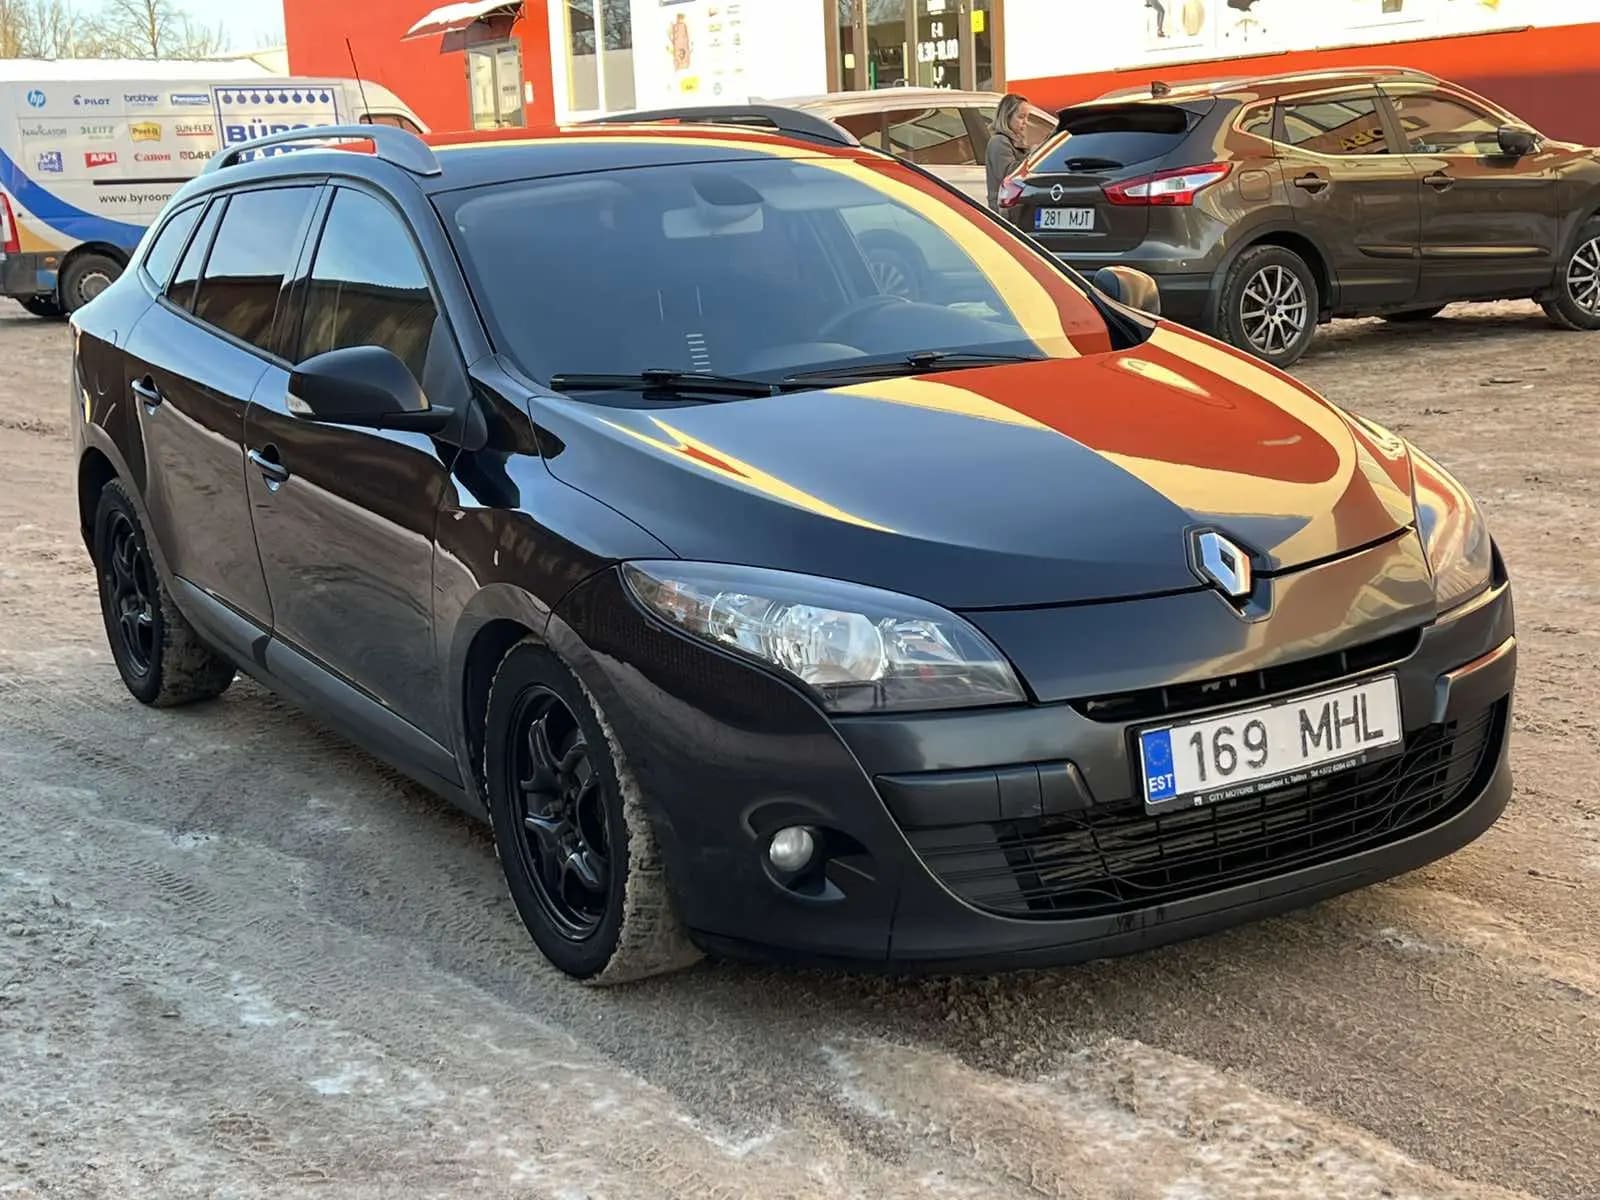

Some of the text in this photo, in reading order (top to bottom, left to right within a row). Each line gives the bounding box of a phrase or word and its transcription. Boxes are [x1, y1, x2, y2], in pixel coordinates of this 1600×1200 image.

[29, 90, 46, 108] hp
[134, 153, 170, 161] Canon
[1044, 211, 1061, 225] 281
[1069, 211, 1090, 225] MJT
[1190, 693, 1384, 782] 169 MHL
[1149, 774, 1173, 793] EST
